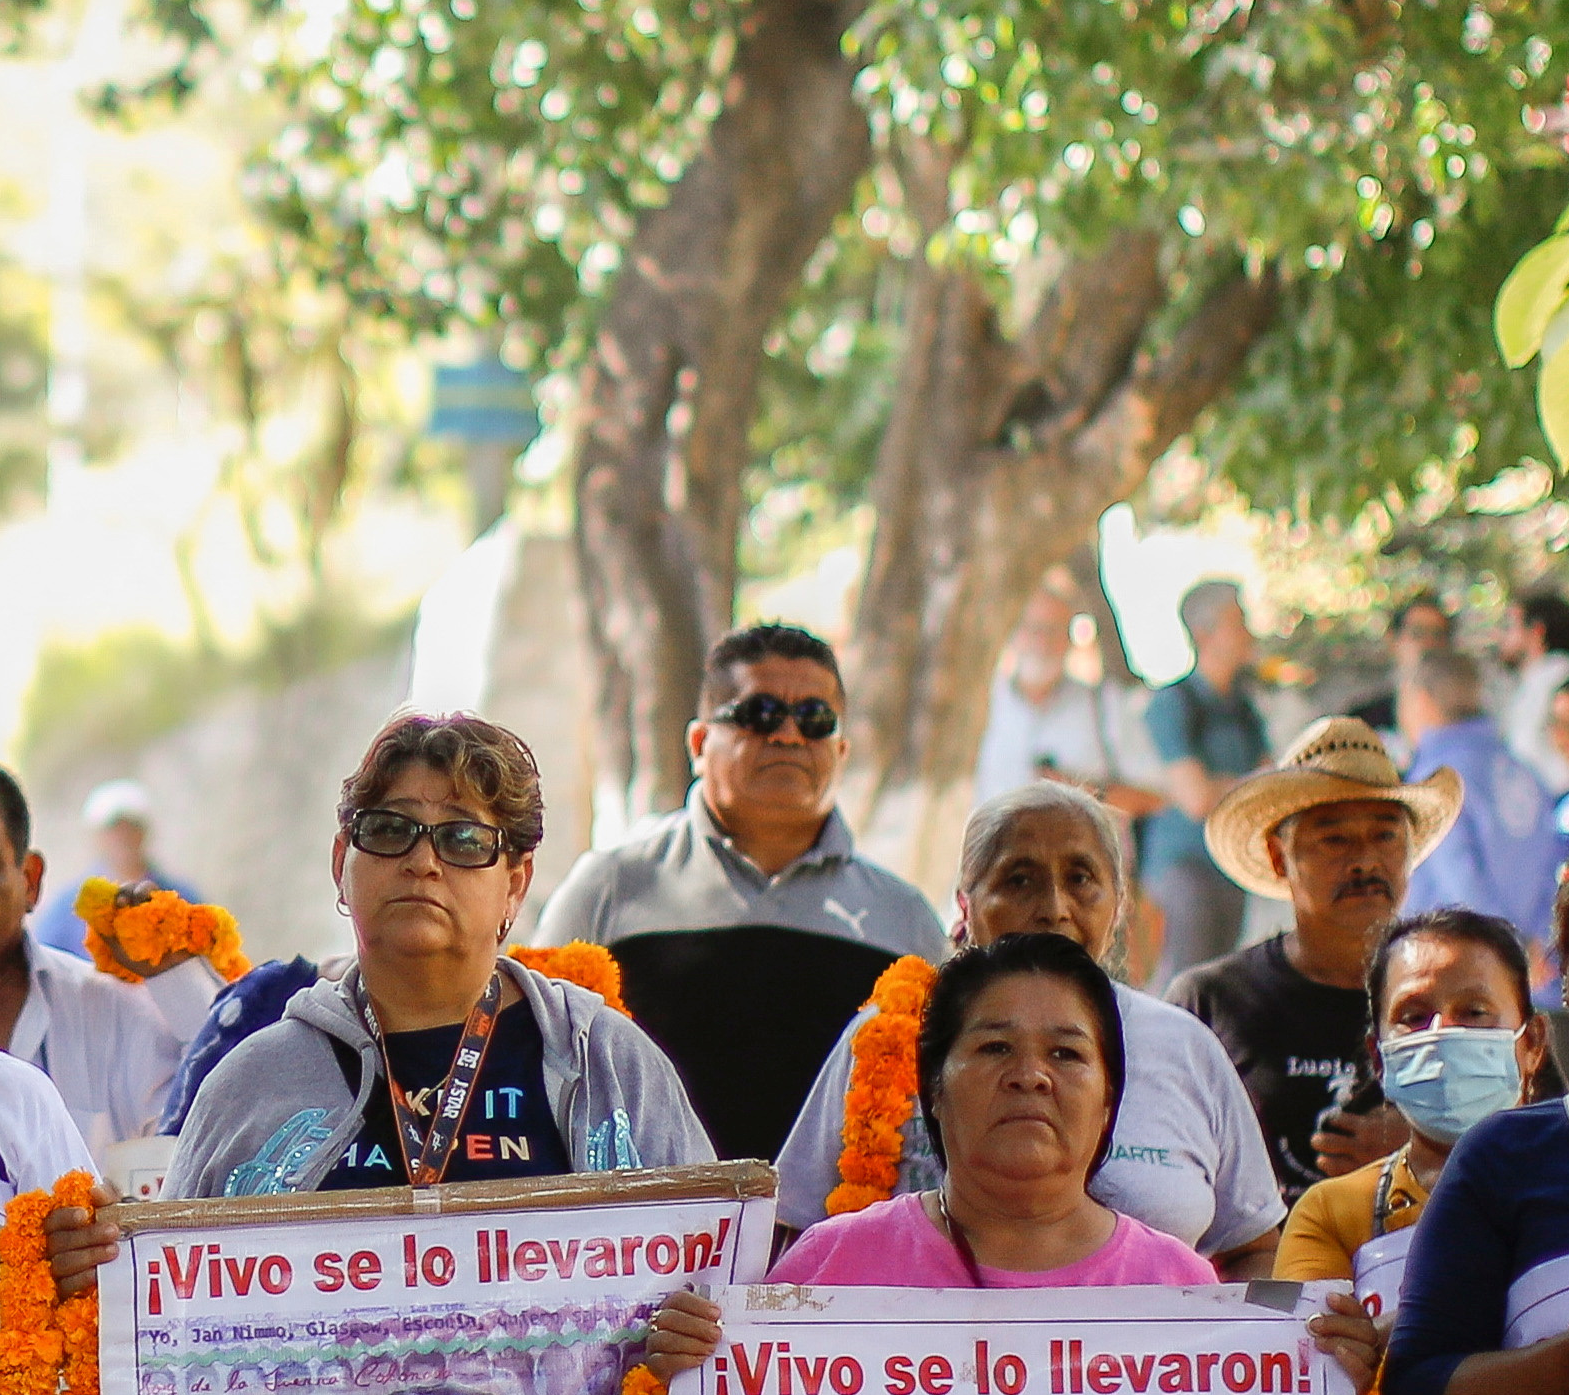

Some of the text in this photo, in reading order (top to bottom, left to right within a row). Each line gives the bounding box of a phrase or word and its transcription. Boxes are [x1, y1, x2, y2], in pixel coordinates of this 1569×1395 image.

[485, 1086, 523, 1119] IT
[147, 1218, 730, 1315] ¡Vivo se lo llevaron!
[149, 1330, 178, 1348] Yo,
[192, 1328, 223, 1344] Jan
[233, 1325, 295, 1343] Nimmo,
[975, 1340, 1027, 1395] lo
[1050, 1338, 1311, 1395] llevaron!
